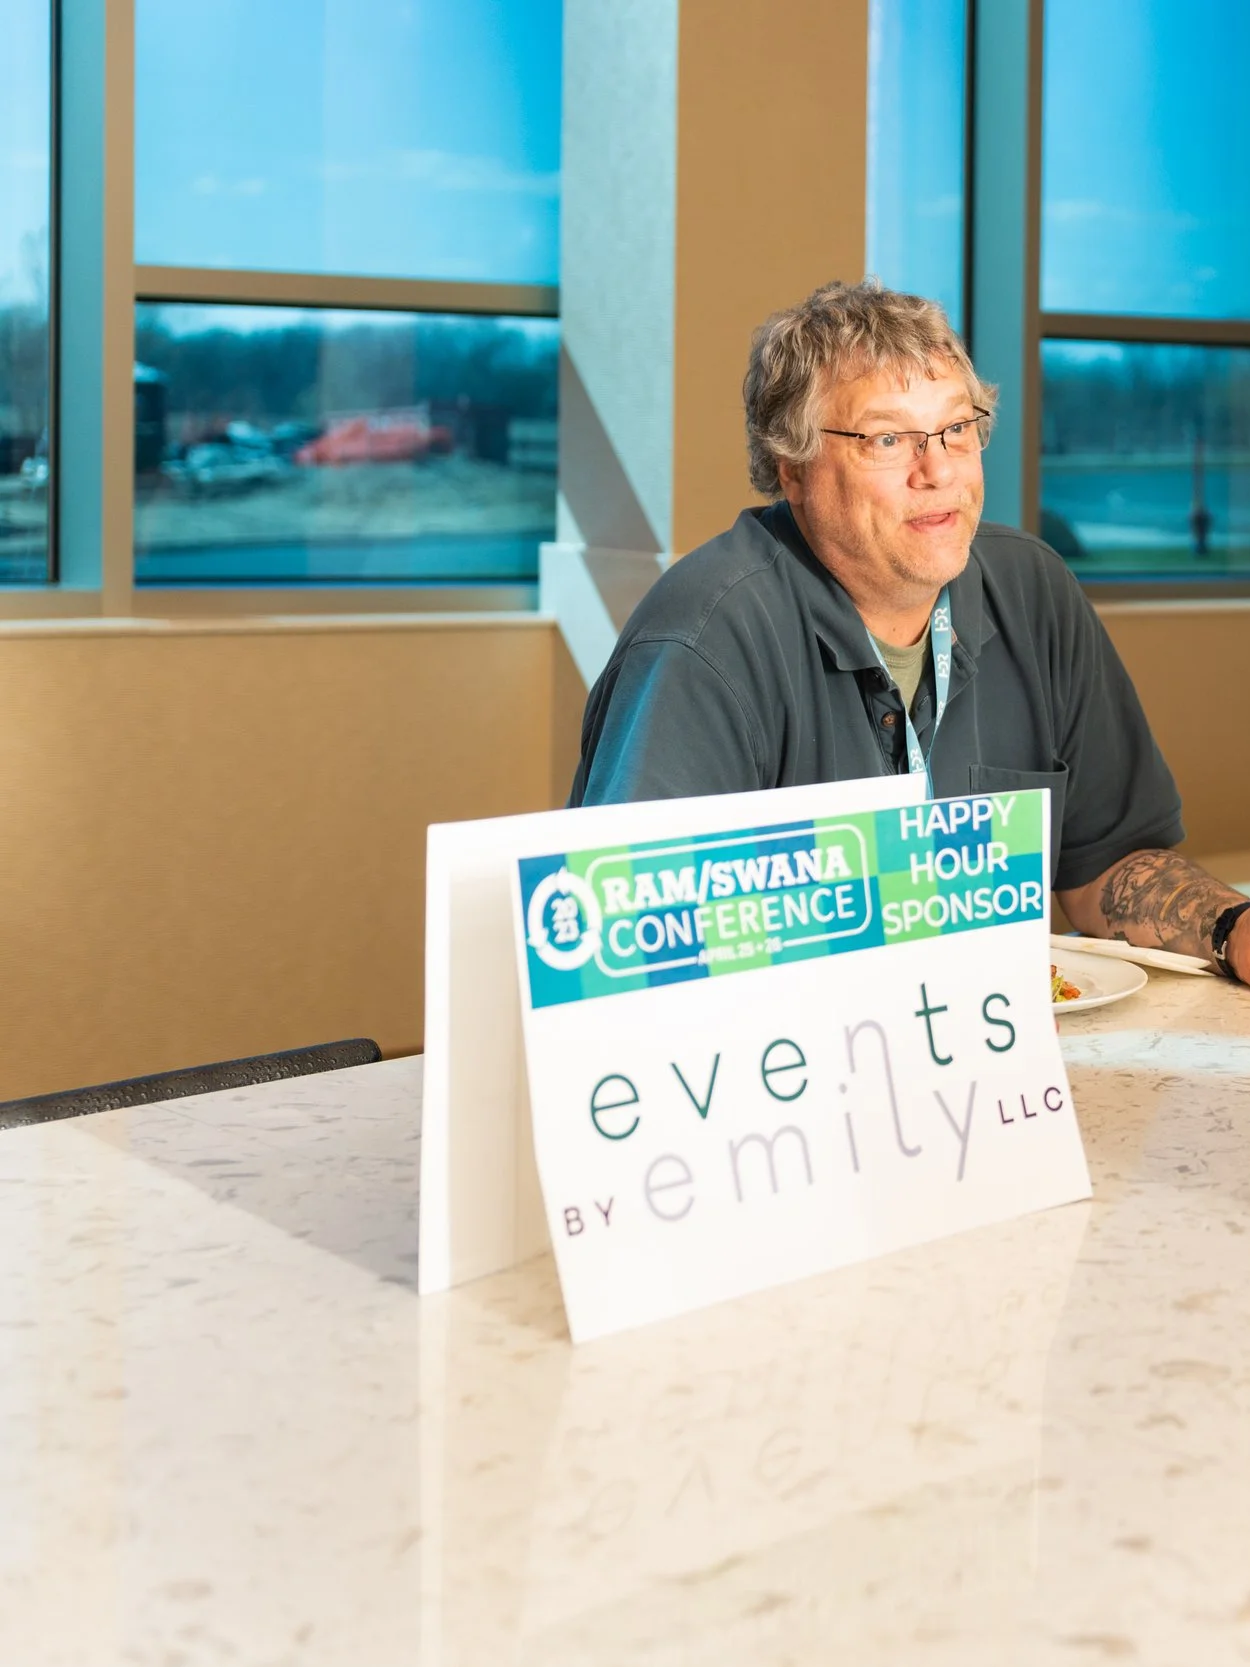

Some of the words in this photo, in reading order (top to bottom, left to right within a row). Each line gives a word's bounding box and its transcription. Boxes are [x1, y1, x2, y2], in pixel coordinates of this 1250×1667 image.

[934, 607, 949, 632] HDR
[938, 653, 949, 678] HDR
[900, 796, 1016, 840] HAPPY
[601, 845, 852, 915] RAM/SWANA
[910, 841, 1009, 885] HOUR
[608, 885, 857, 957] CONFERENCE
[882, 881, 1043, 936] SPONSOR
[590, 982, 1016, 1141] events
[564, 1196, 614, 1237] BY
[645, 1056, 977, 1222] emily
[998, 1086, 1063, 1124] LLC
